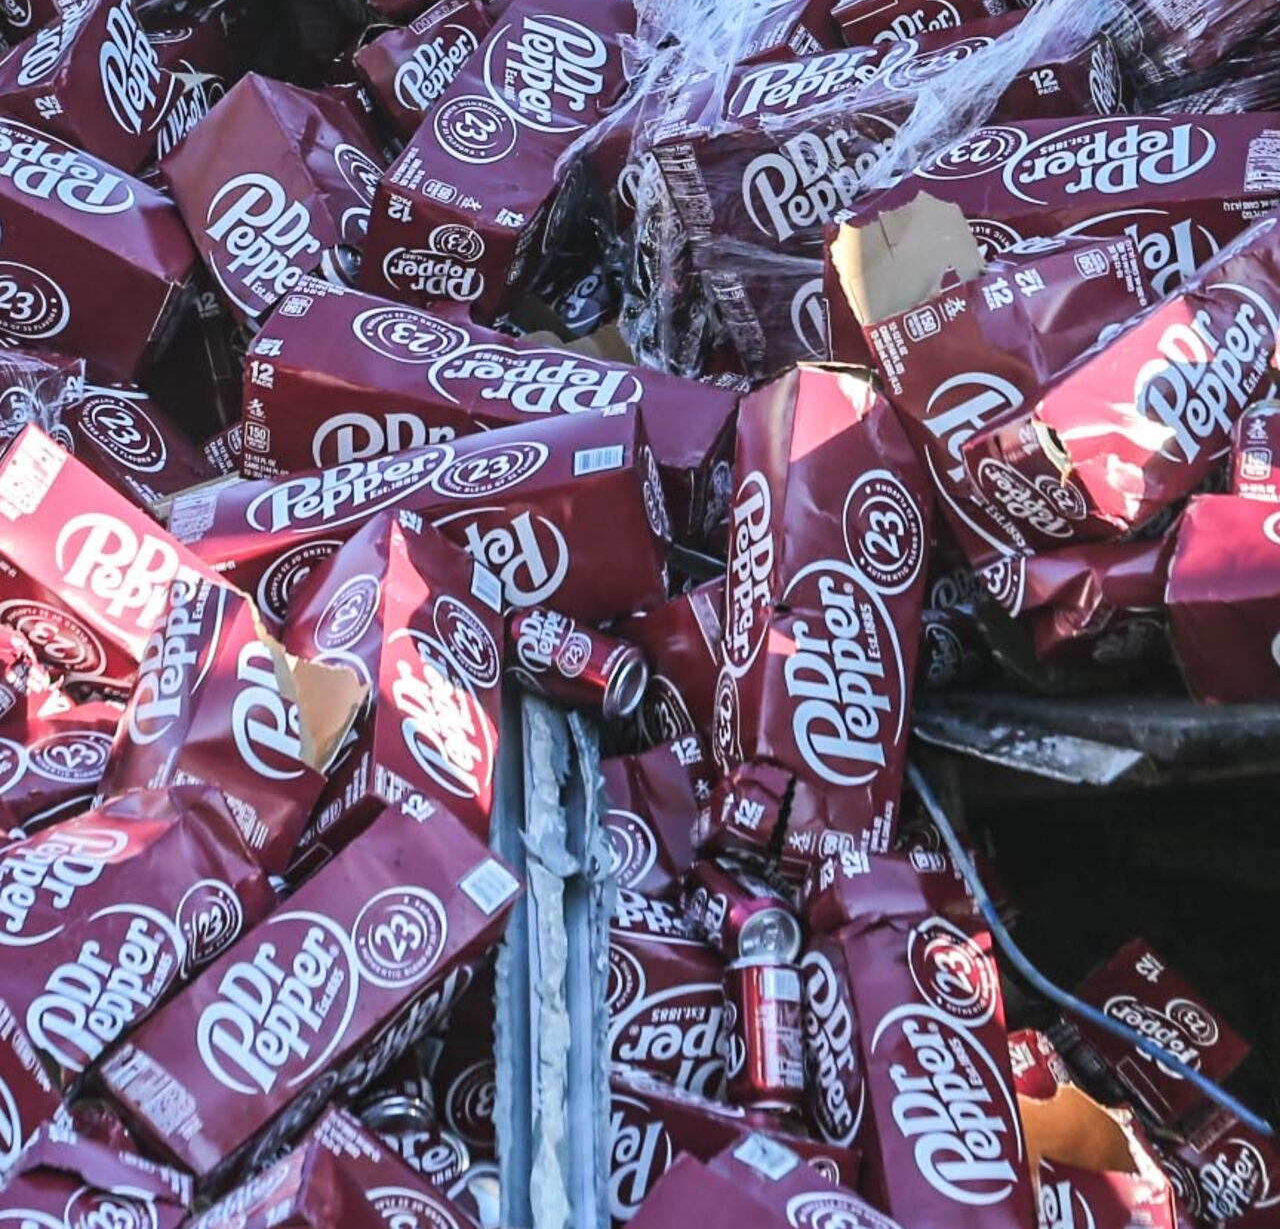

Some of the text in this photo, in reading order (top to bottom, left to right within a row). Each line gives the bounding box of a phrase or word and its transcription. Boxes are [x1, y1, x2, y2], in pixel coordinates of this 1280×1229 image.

[541, 61, 605, 131] Dr
[1038, 82, 1062, 96] PACK
[461, 114, 497, 143] 23
[964, 137, 998, 162] 23
[1040, 133, 1090, 152] Est.1885
[1020, 123, 1216, 191] Pepper
[1066, 159, 1128, 193] Dr
[385, 204, 413, 222] 12
[385, 246, 482, 299] Pepper
[392, 323, 436, 356] 23
[1157, 306, 1220, 371] Dr
[252, 377, 274, 388] PACK
[444, 357, 633, 415] Pepper
[247, 449, 438, 533] Pepper
[469, 458, 509, 481] 23
[875, 483, 907, 508] FLAVORS
[863, 509, 906, 562] 23
[908, 537, 918, 565] BLEND
[733, 471, 770, 659] Pepper
[867, 566, 909, 582] AUTHENTIC
[785, 623, 829, 700] Dr
[792, 578, 890, 786] Pepper
[375, 917, 420, 955] 23
[26, 919, 159, 1072] Pepper
[51, 944, 102, 1004] Dr
[217, 944, 277, 1014] Dr
[935, 947, 976, 993] 23
[197, 928, 337, 1094] Pepper
[889, 1067, 935, 1135] Dr
[909, 1020, 1018, 1204] Pepper
